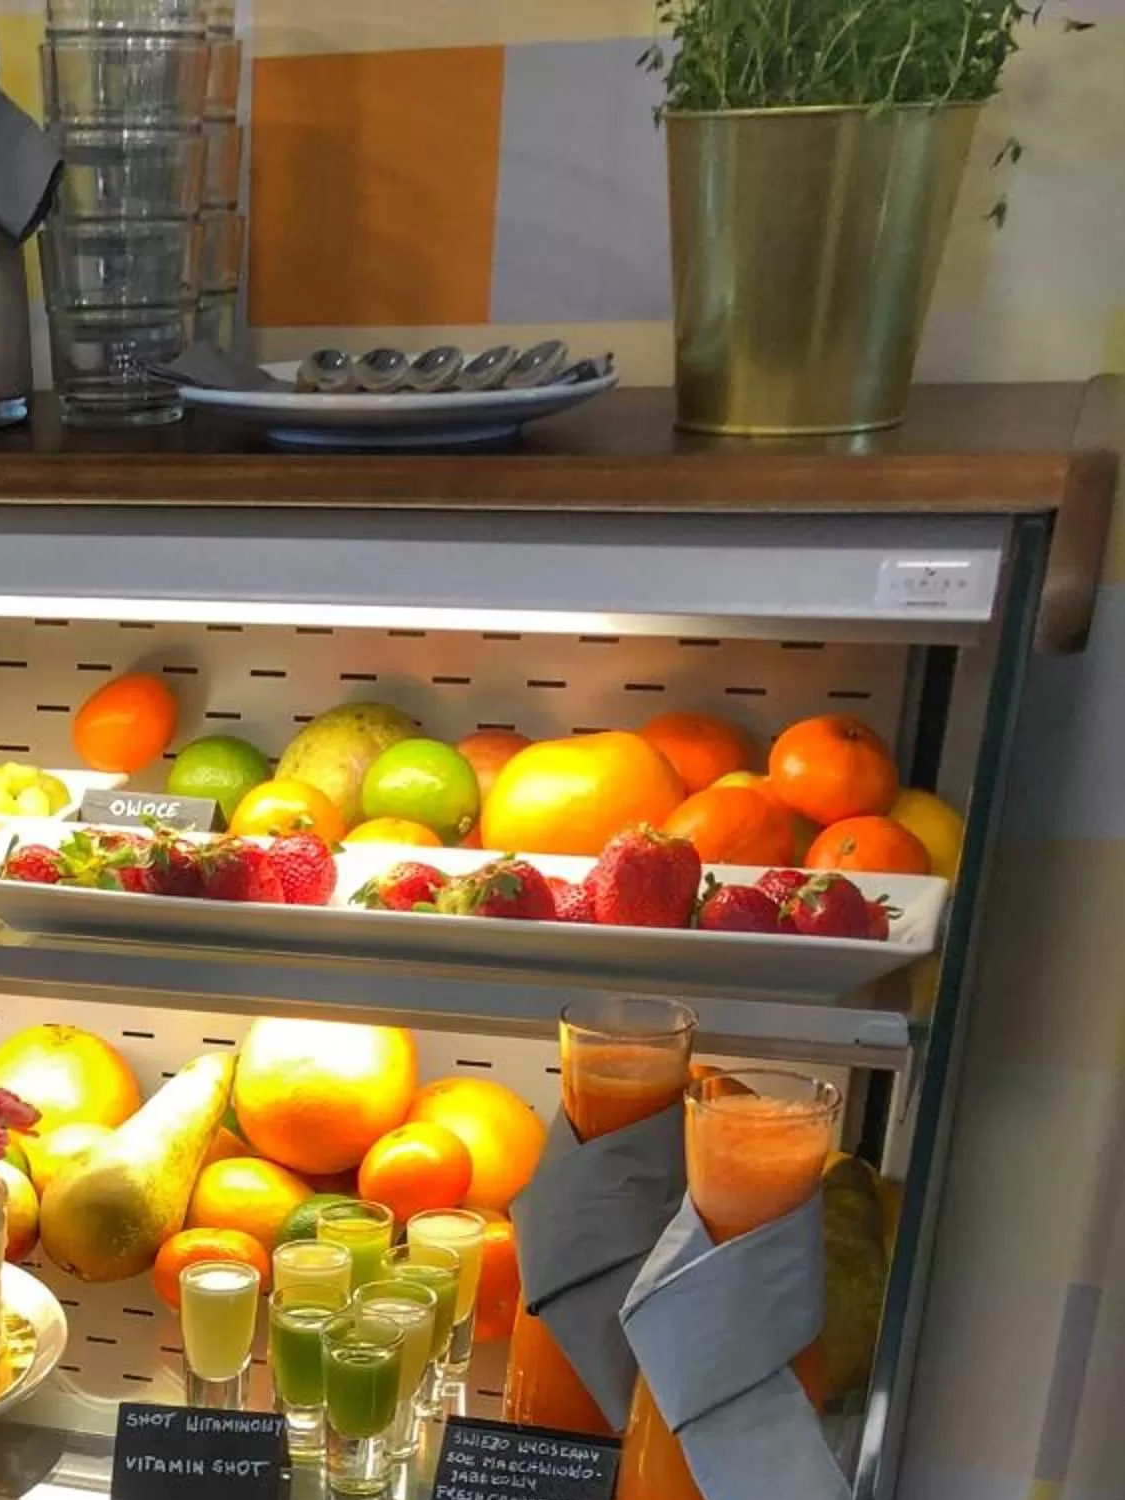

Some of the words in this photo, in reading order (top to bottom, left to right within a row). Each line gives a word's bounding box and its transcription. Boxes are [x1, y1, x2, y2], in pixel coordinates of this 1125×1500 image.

[108, 799, 181, 819] OWOCE
[125, 1410, 178, 1431] SHOT
[185, 1414, 285, 1438] WITAMINOWY
[125, 1454, 205, 1476] VITAMIN
[211, 1458, 271, 1478] SHOT
